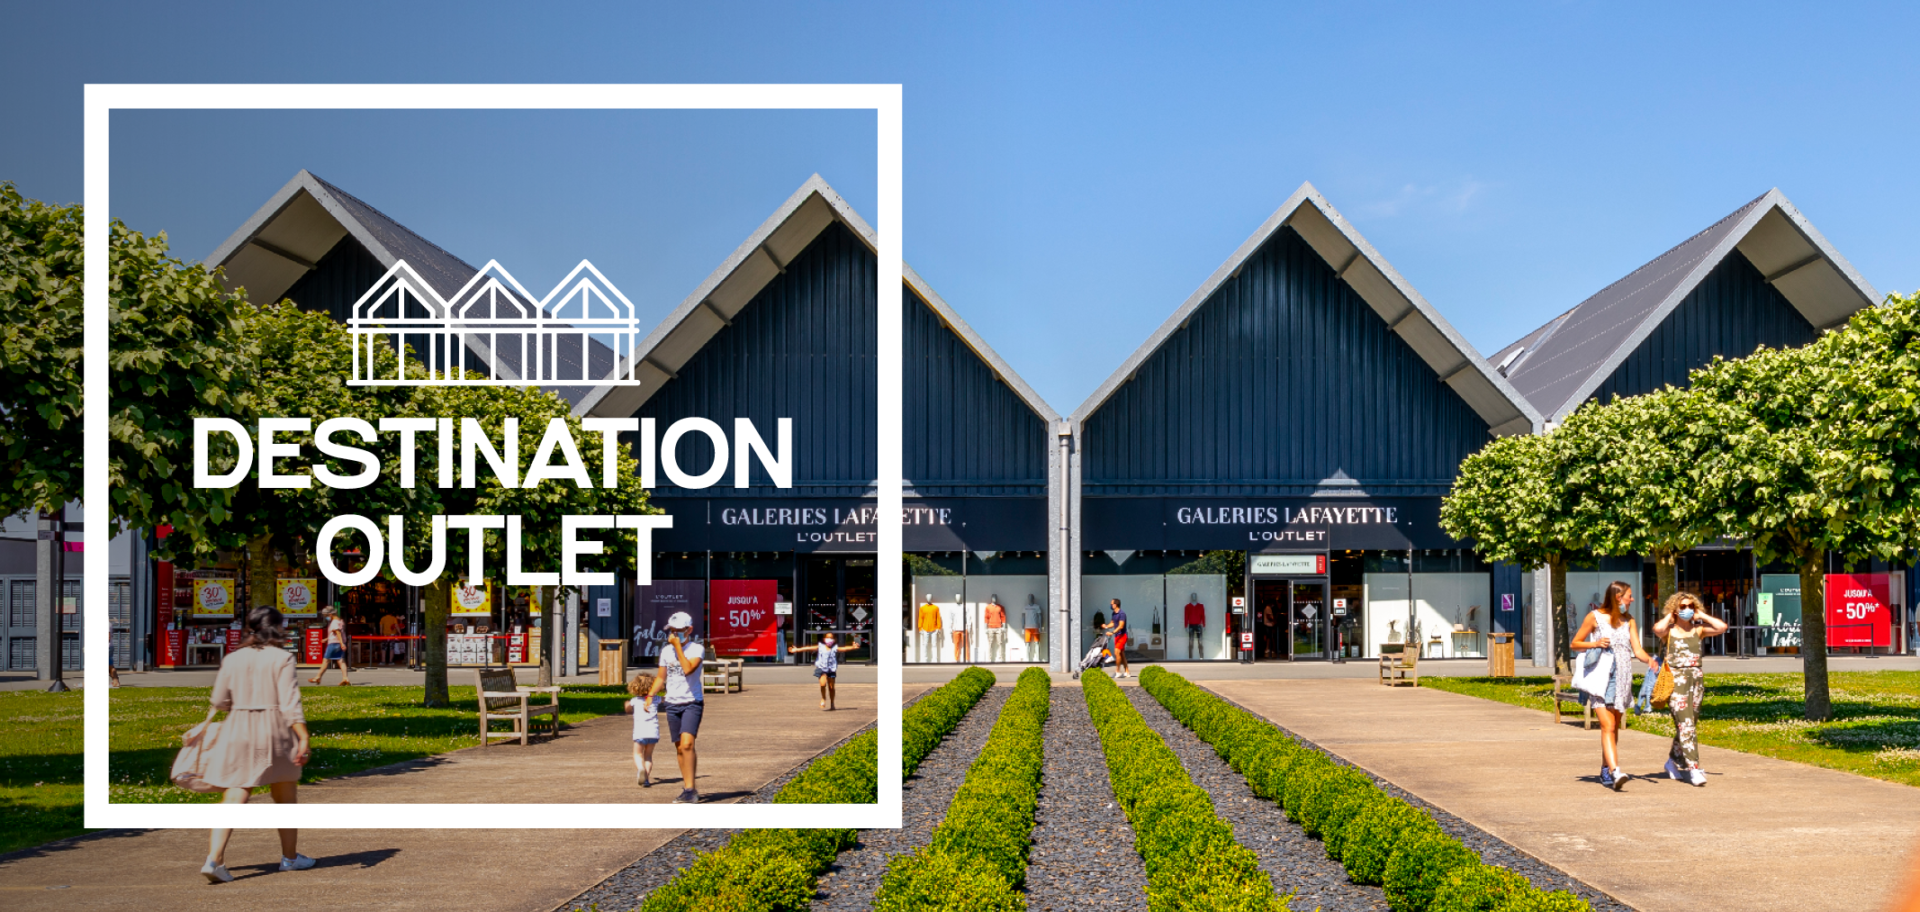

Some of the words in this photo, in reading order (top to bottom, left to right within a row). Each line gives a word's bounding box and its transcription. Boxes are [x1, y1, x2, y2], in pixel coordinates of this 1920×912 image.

[722, 508, 827, 525] GALERIES
[1177, 507, 1278, 524] GALERIES
[1285, 506, 1398, 524] LAFAYETTE
[797, 531, 877, 543] L'OUTLET
[1249, 530, 1326, 541] L'OUTLET
